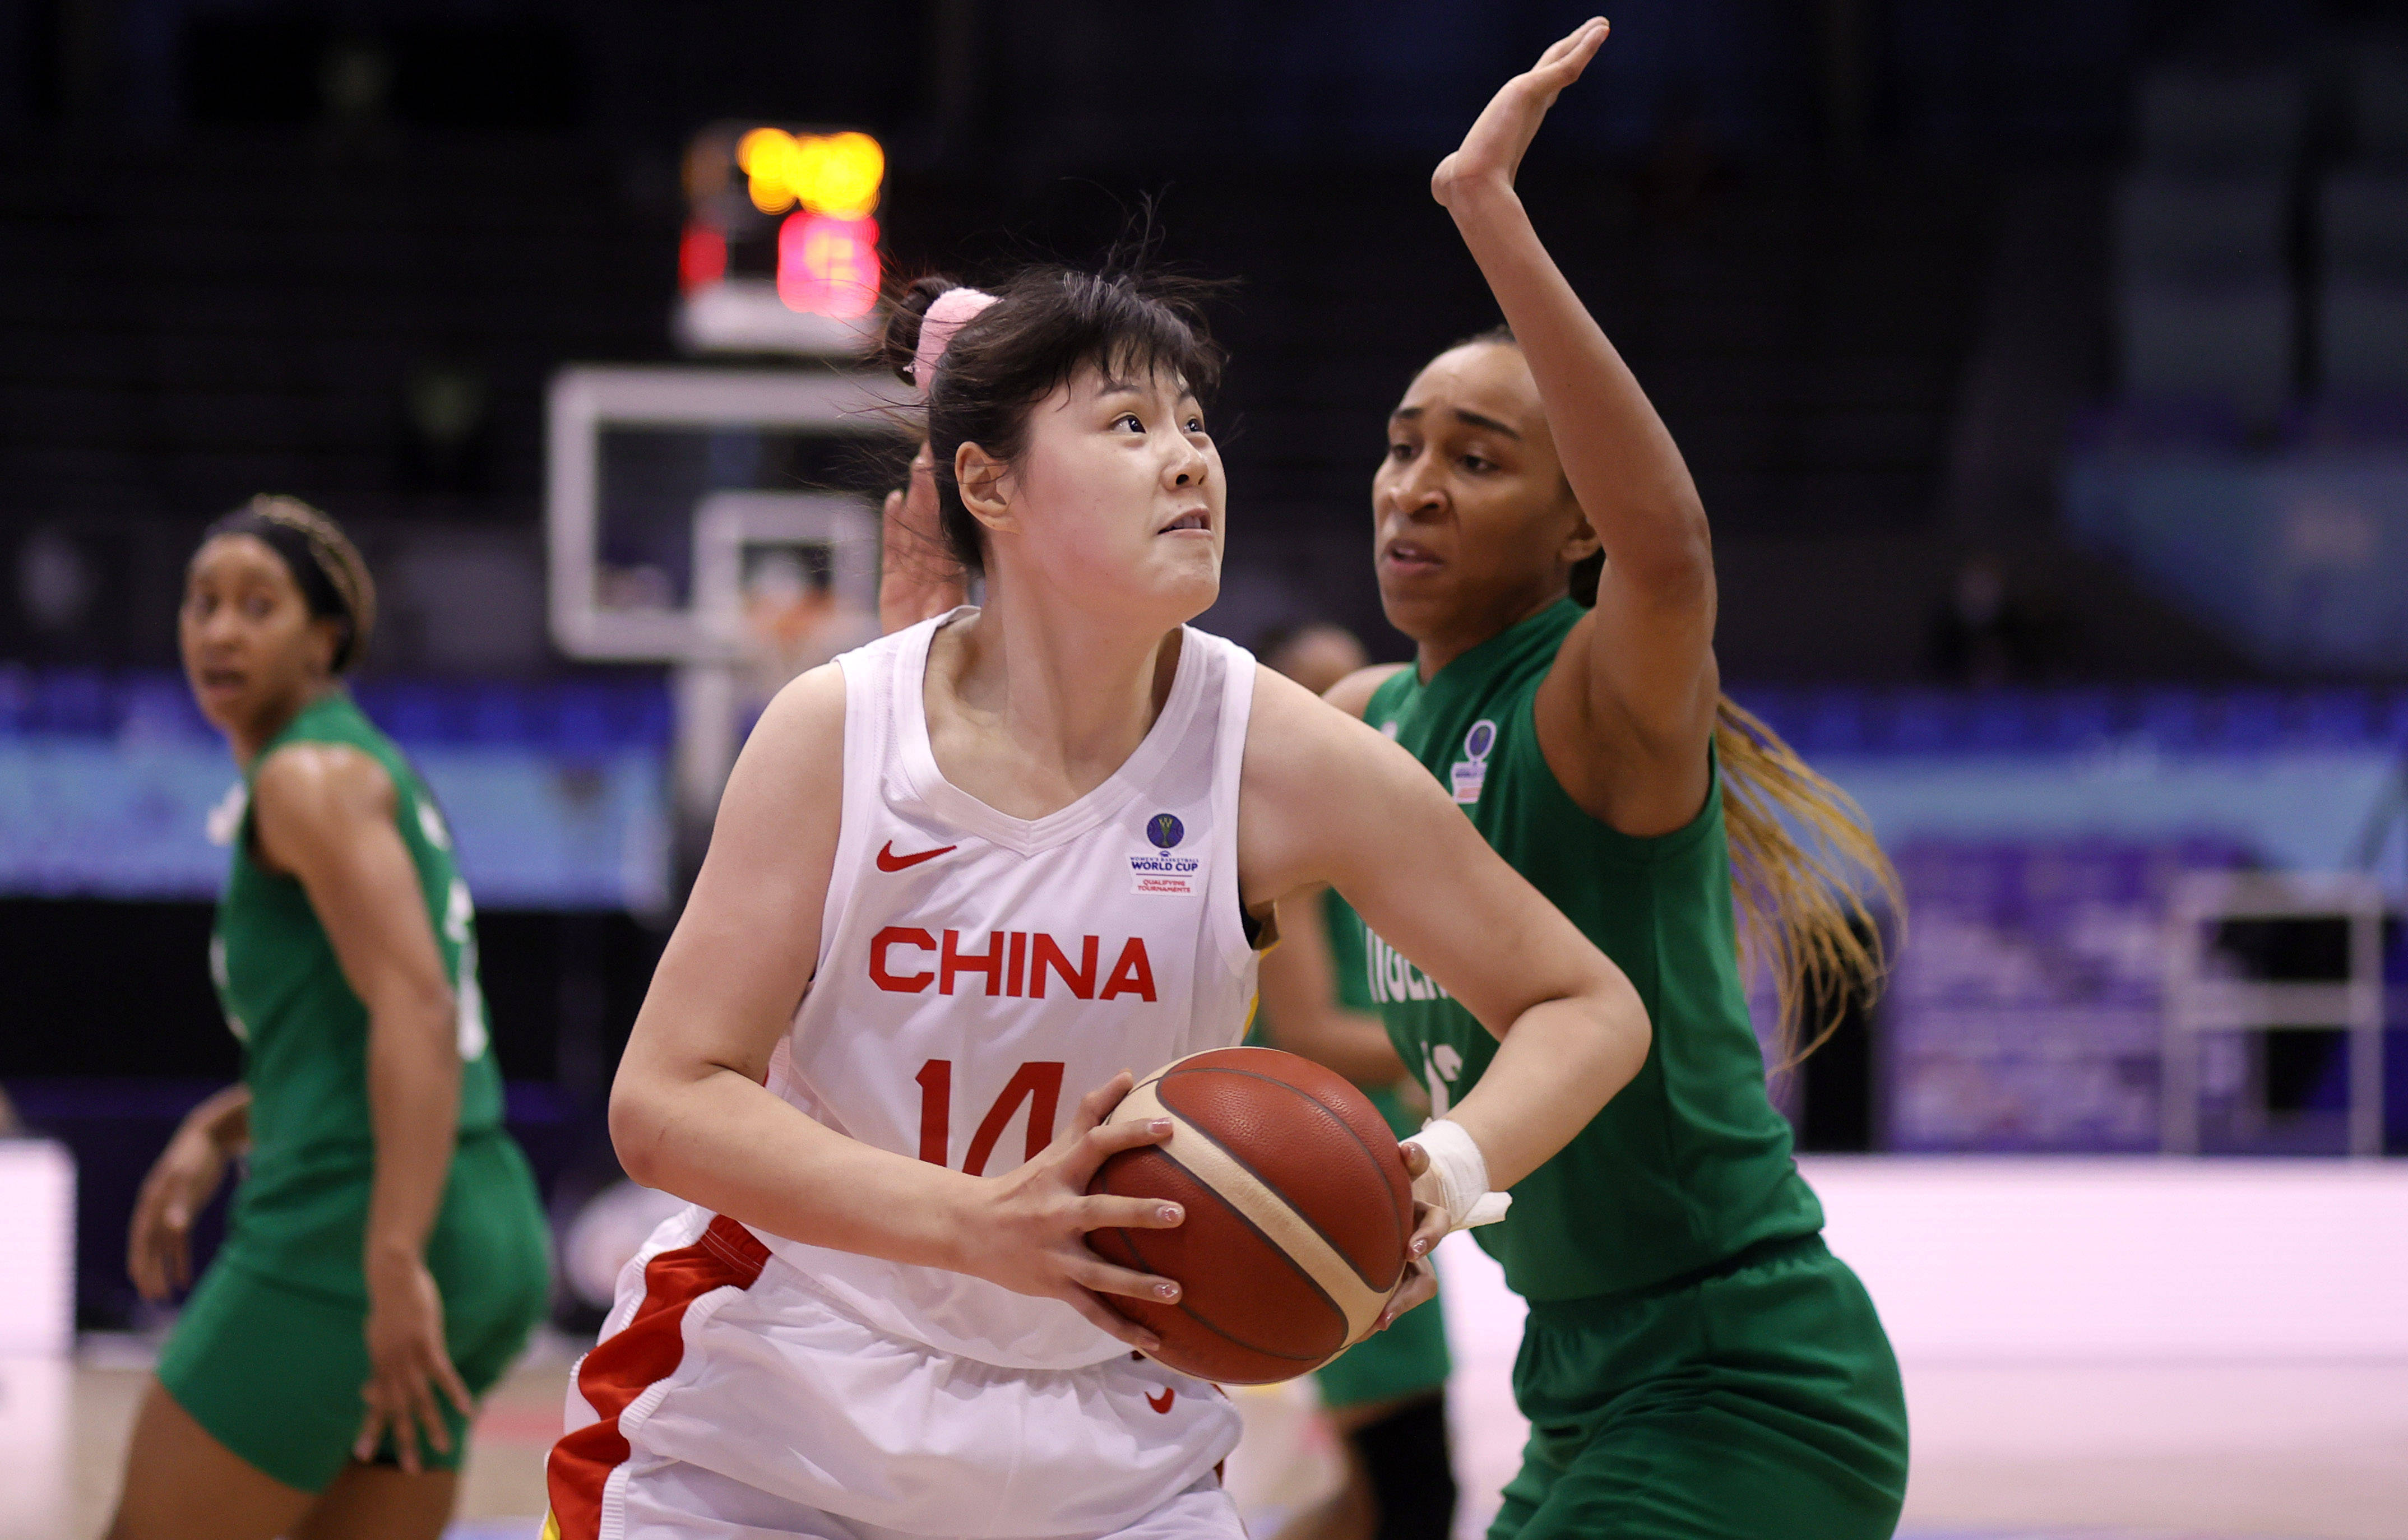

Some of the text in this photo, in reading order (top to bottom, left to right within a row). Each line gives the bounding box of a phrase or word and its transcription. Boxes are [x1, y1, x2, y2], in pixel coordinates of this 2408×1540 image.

[1132, 862, 1198, 871] WORLD CUP
[869, 926, 1157, 1002] CHINA
